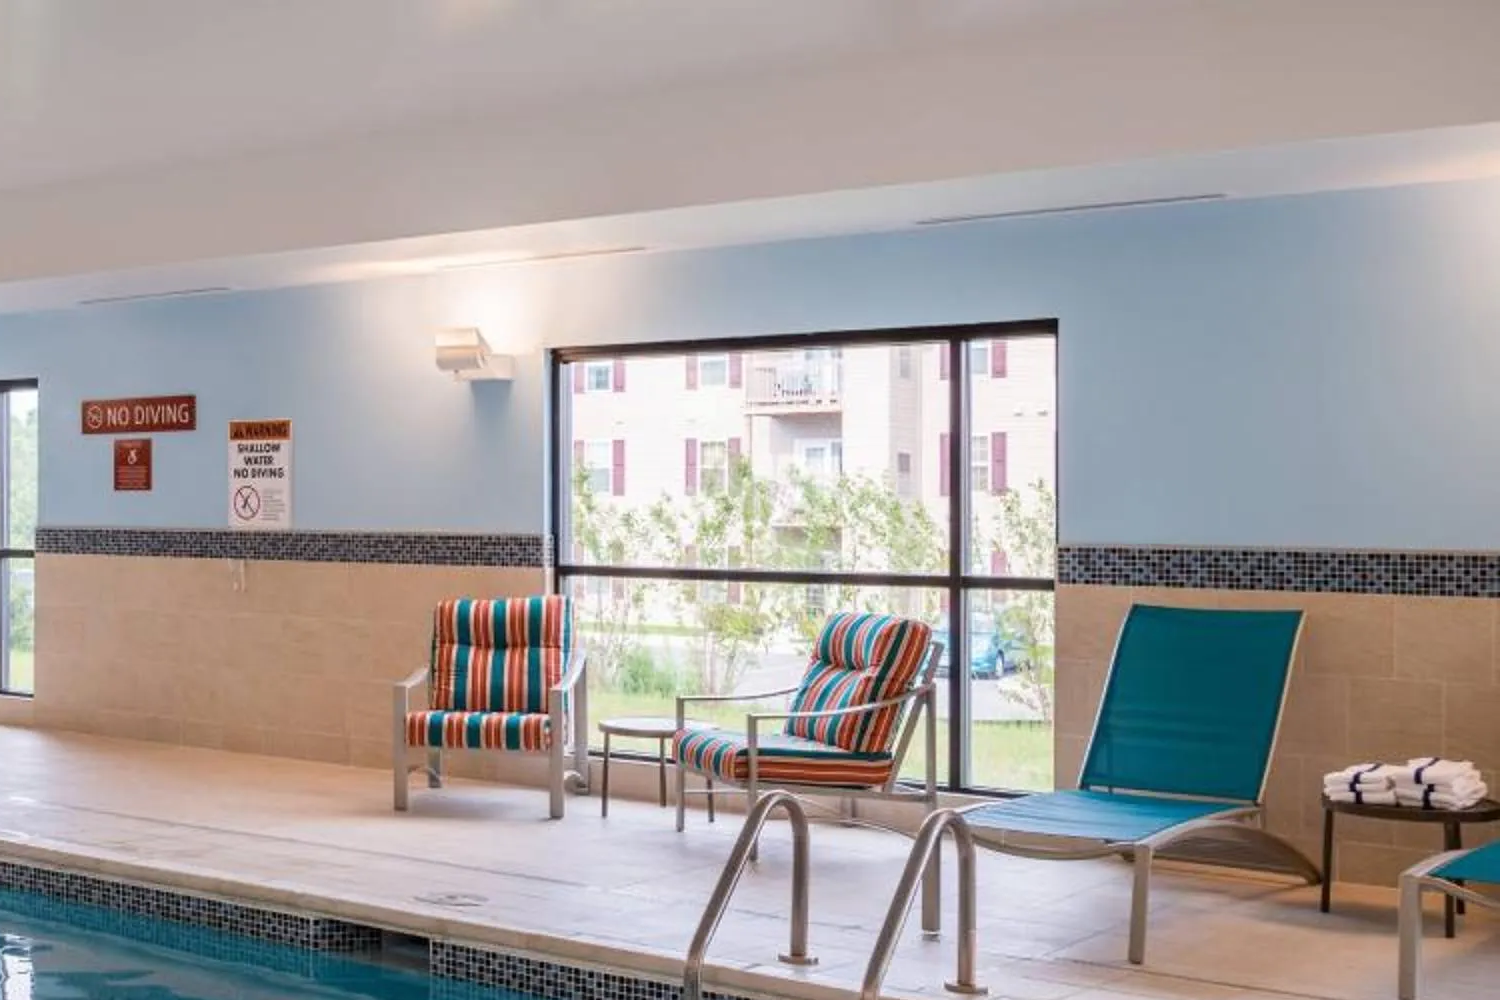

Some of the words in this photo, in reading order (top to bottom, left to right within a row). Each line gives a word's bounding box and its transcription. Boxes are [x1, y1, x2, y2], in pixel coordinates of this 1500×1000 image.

[107, 405, 129, 426] NO
[134, 403, 189, 425] DIVING
[237, 443, 281, 453] SHALLOW
[243, 455, 275, 466] WATER
[233, 467, 249, 479] NO
[251, 467, 284, 479] DIVING
